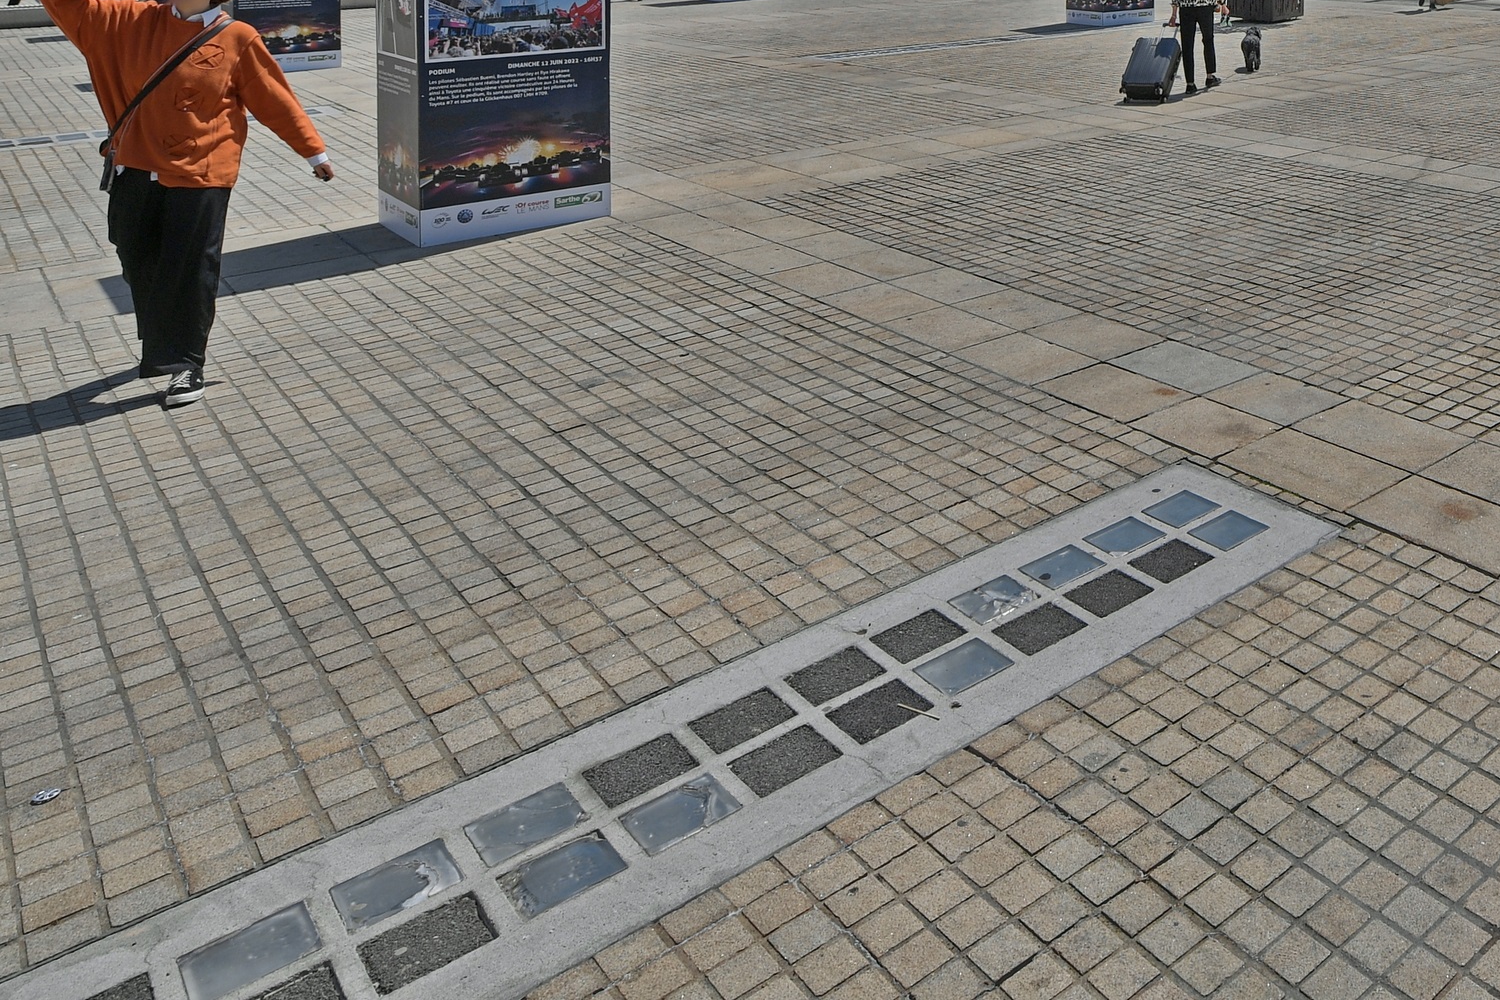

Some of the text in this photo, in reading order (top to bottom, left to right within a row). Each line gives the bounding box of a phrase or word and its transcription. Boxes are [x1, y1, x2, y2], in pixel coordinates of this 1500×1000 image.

[528, 199, 549, 207] course
[556, 195, 581, 205] Sarthe
[528, 204, 550, 212] MANS
